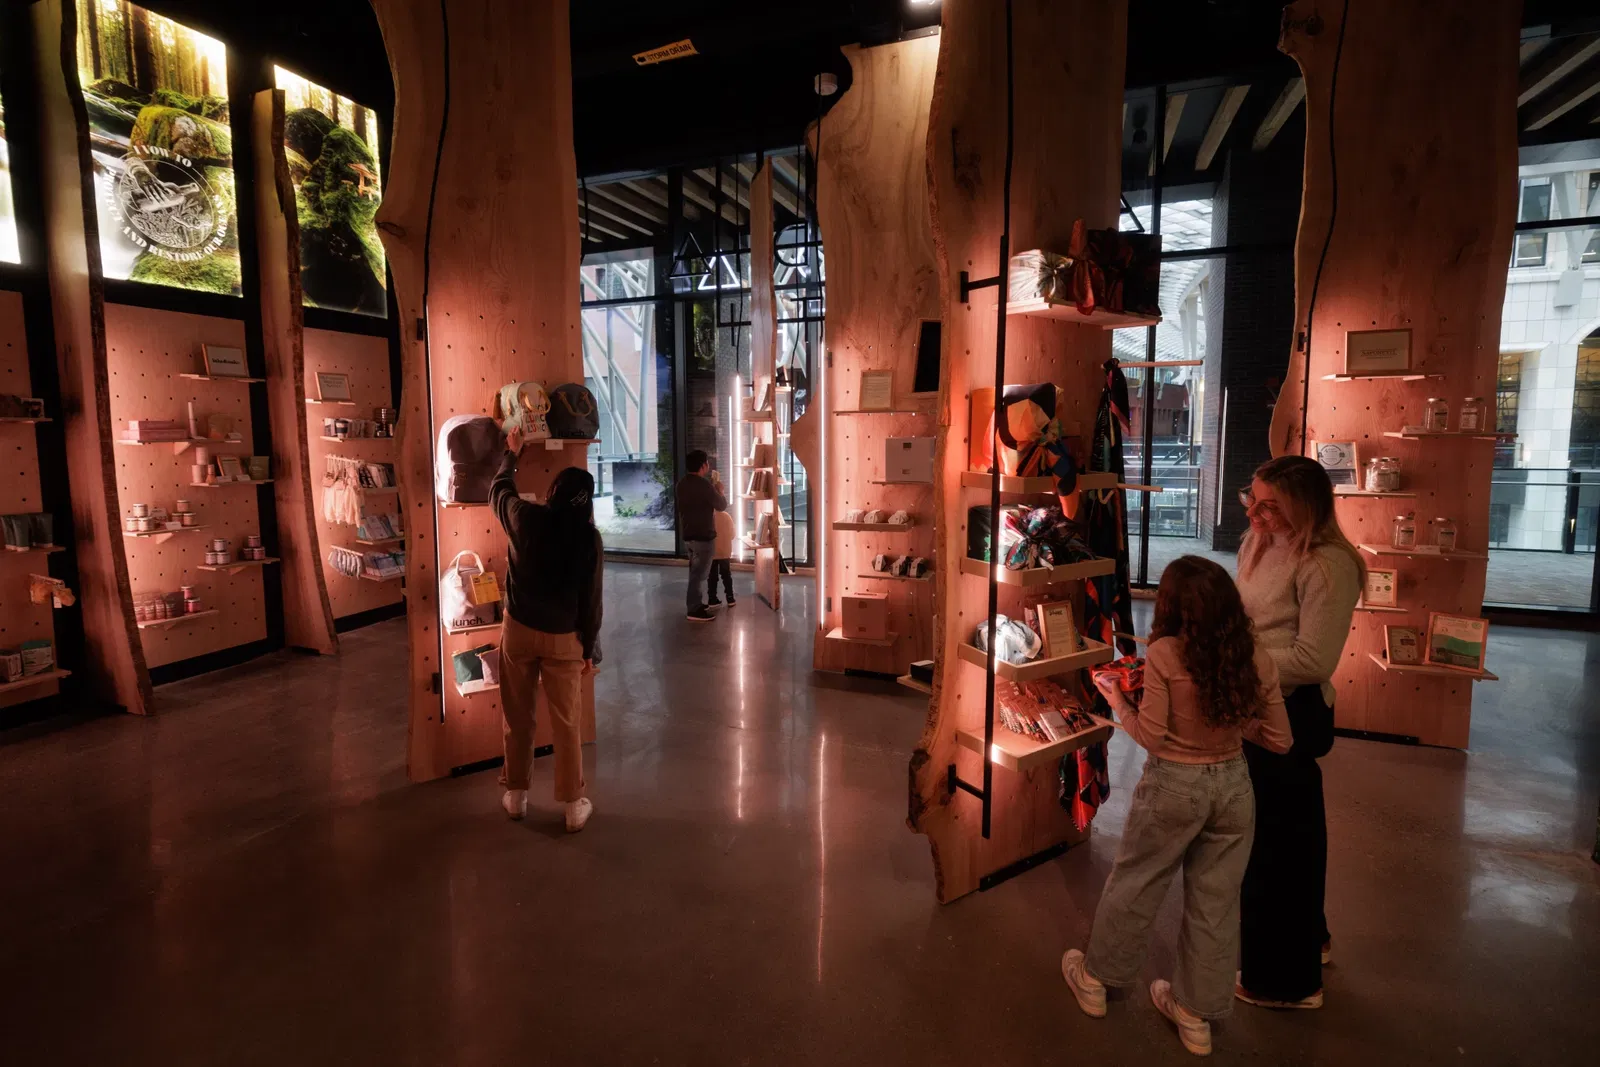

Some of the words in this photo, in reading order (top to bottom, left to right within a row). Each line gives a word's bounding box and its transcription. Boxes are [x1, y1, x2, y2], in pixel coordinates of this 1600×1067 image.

[647, 51, 670, 61] STORM
[669, 44, 692, 55] DRAIN
[175, 153, 192, 167] TO
[120, 226, 148, 248] AND
[148, 244, 204, 261] RESTORE
[203, 236, 223, 255] OUR
